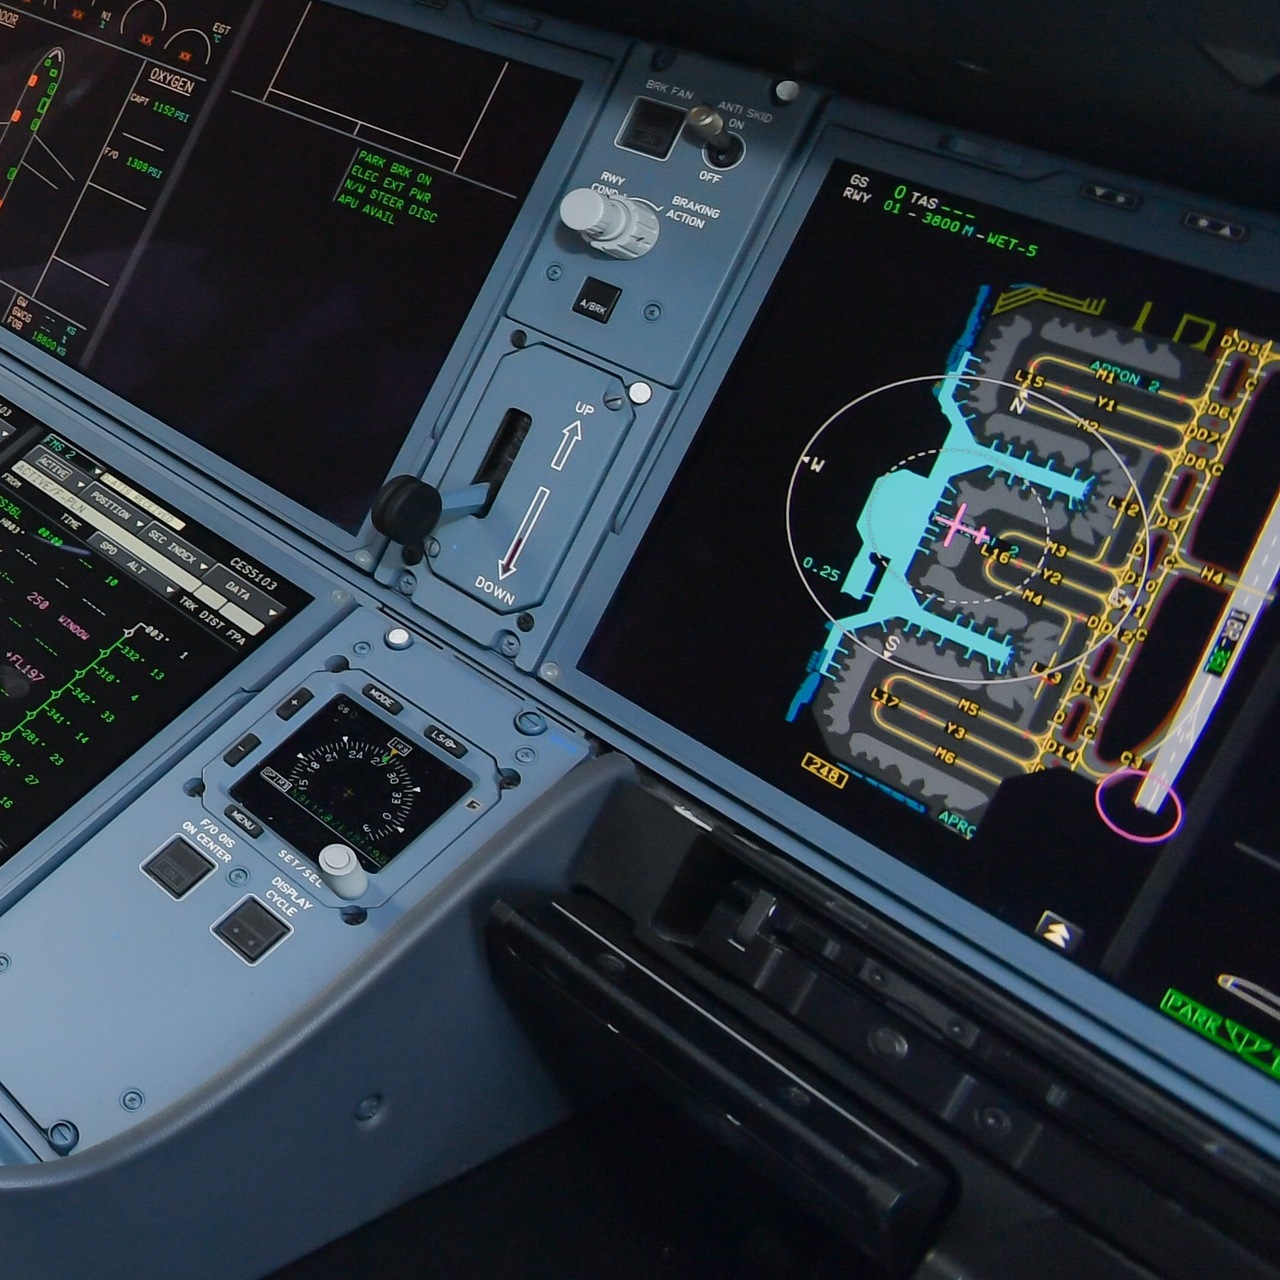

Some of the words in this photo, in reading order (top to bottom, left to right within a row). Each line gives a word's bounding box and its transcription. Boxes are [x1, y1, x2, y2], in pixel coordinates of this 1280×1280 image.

[212, 23, 231, 35] EGT
[150, 68, 195, 93] OXYGEN
[645, 78, 668, 95] BRK
[670, 85, 694, 101] FAN
[130, 92, 150, 107] CAPT
[152, 101, 175, 118] 1152
[717, 99, 743, 116] ANTI
[744, 107, 773, 124] SKID
[728, 117, 745, 130] ON
[104, 147, 119, 160] F/O
[126, 156, 149, 174] 1309
[358, 149, 387, 170] PARK
[390, 161, 414, 179] BRK
[417, 172, 433, 185] ON
[351, 165, 379, 184] ELEC
[383, 176, 405, 194] EXT
[407, 186, 432, 204] PWR
[600, 170, 626, 186] RWY
[698, 169, 722, 184] OFF
[344, 178, 366, 196] N/W
[369, 188, 405, 211] STEER
[408, 204, 438, 223] DISC
[849, 173, 870, 188] GS
[910, 190, 939, 209] TAS
[337, 194, 360, 210] APU
[361, 203, 395, 225] AVAIL
[665, 208, 705, 230] ACTION
[671, 194, 720, 220] BRAKING
[842, 186, 872, 204] RWY
[883, 199, 902, 215] 01
[921, 210, 960, 233] 3800
[986, 231, 1039, 258] WET-5
[579, 296, 607, 316] A/BRK
[1014, 369, 1044, 388] L15
[574, 400, 595, 416] UP
[45, 434, 65, 453] FMS
[39, 454, 69, 479] ACTIVE
[90, 490, 132, 521] POSITION
[99, 540, 119, 557] SPD
[126, 559, 147, 577] ALT
[147, 527, 168, 548] SEC
[169, 540, 198, 565] INDEX
[980, 544, 1010, 565] L16
[1045, 540, 1068, 558] M3
[229, 556, 279, 592] CES5103
[801, 555, 842, 583] 0.25
[1041, 567, 1062, 585] Y2
[225, 580, 251, 601] DATA
[473, 575, 516, 606] DOWN
[1022, 588, 1044, 607] M4
[58, 614, 91, 641] WINDOW
[179, 595, 201, 614] TRK
[225, 627, 247, 646] FPA
[368, 686, 396, 710] MODE
[870, 687, 901, 709] L17
[957, 698, 980, 717] M5
[945, 721, 965, 739] Y3
[934, 746, 956, 765] M6
[808, 759, 840, 783] 248
[229, 808, 257, 833] MENU
[181, 819, 200, 836] ON
[195, 830, 233, 865] CENTER
[200, 818, 223, 838] F/O
[216, 831, 236, 849] OIS
[276, 848, 323, 890] SET/SEL
[264, 888, 298, 918] CYCLE
[270, 875, 314, 912] DISPLAY
